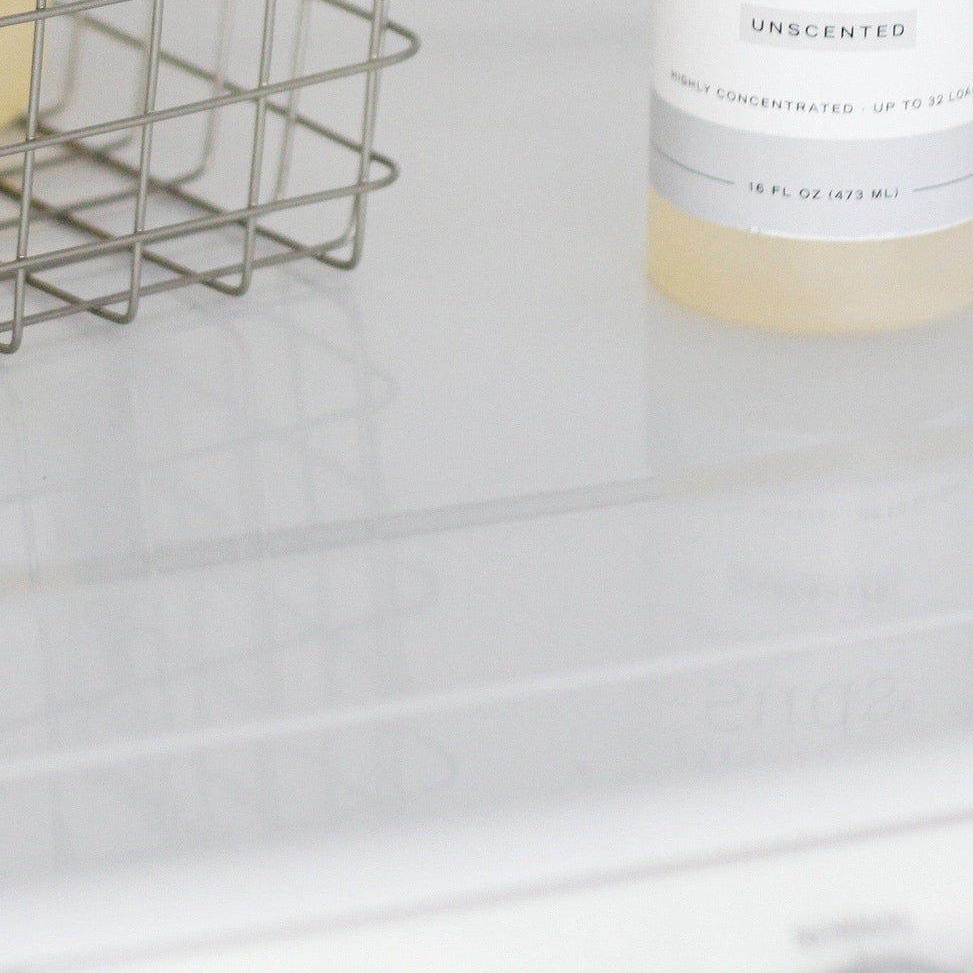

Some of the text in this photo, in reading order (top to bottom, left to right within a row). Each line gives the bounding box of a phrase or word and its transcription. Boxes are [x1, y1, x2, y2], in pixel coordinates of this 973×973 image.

[751, 17, 906, 39] UNSCENTED
[670, 69, 711, 95] HIGHLY
[716, 87, 854, 115] CONCENTRATED
[873, 101, 896, 113] UP
[903, 98, 922, 110] TO
[928, 93, 944, 107] 32
[749, 181, 899, 201] 16 FL OZ (473 ML)
